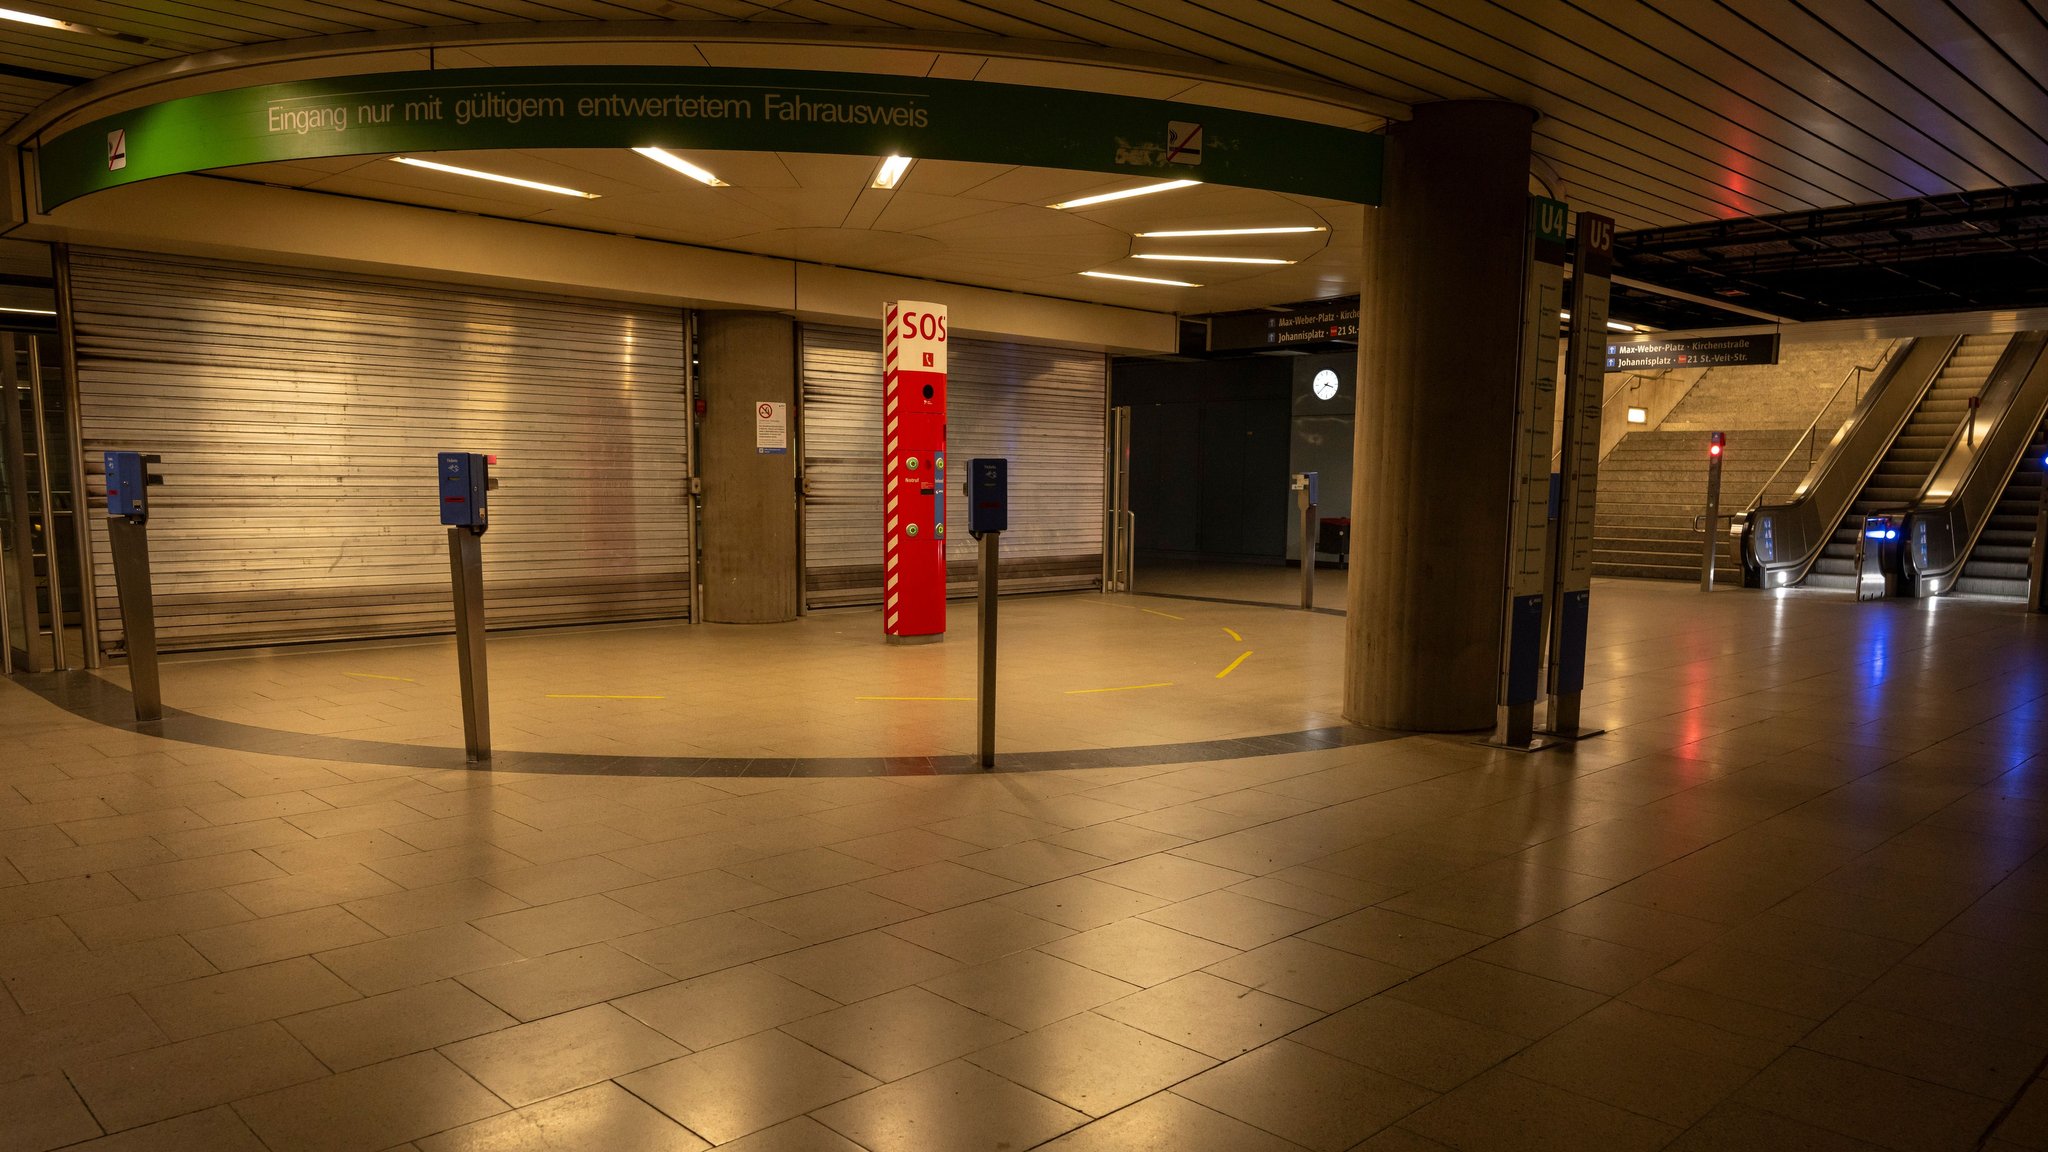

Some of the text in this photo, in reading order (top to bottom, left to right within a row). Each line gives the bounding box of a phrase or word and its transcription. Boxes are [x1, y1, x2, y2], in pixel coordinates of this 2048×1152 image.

[268, 91, 929, 134] Eingang nur mit gültigem entwertetem Fahrausweis
[1541, 203, 1563, 238] U4
[1591, 219, 1610, 251] U5
[902, 311, 946, 342] SOS
[1279, 312, 1334, 327] Max-Weber-Platz
[1278, 329, 1325, 343] Johannisplatz
[1338, 326, 1346, 336] 21
[1619, 340, 1750, 354] Max-Weber-Platz Kirchenstraße
[1618, 357, 1671, 368] Johannisplatz
[1687, 355, 1698, 363] 21
[1700, 353, 1748, 363] St.-Veit-Str.
